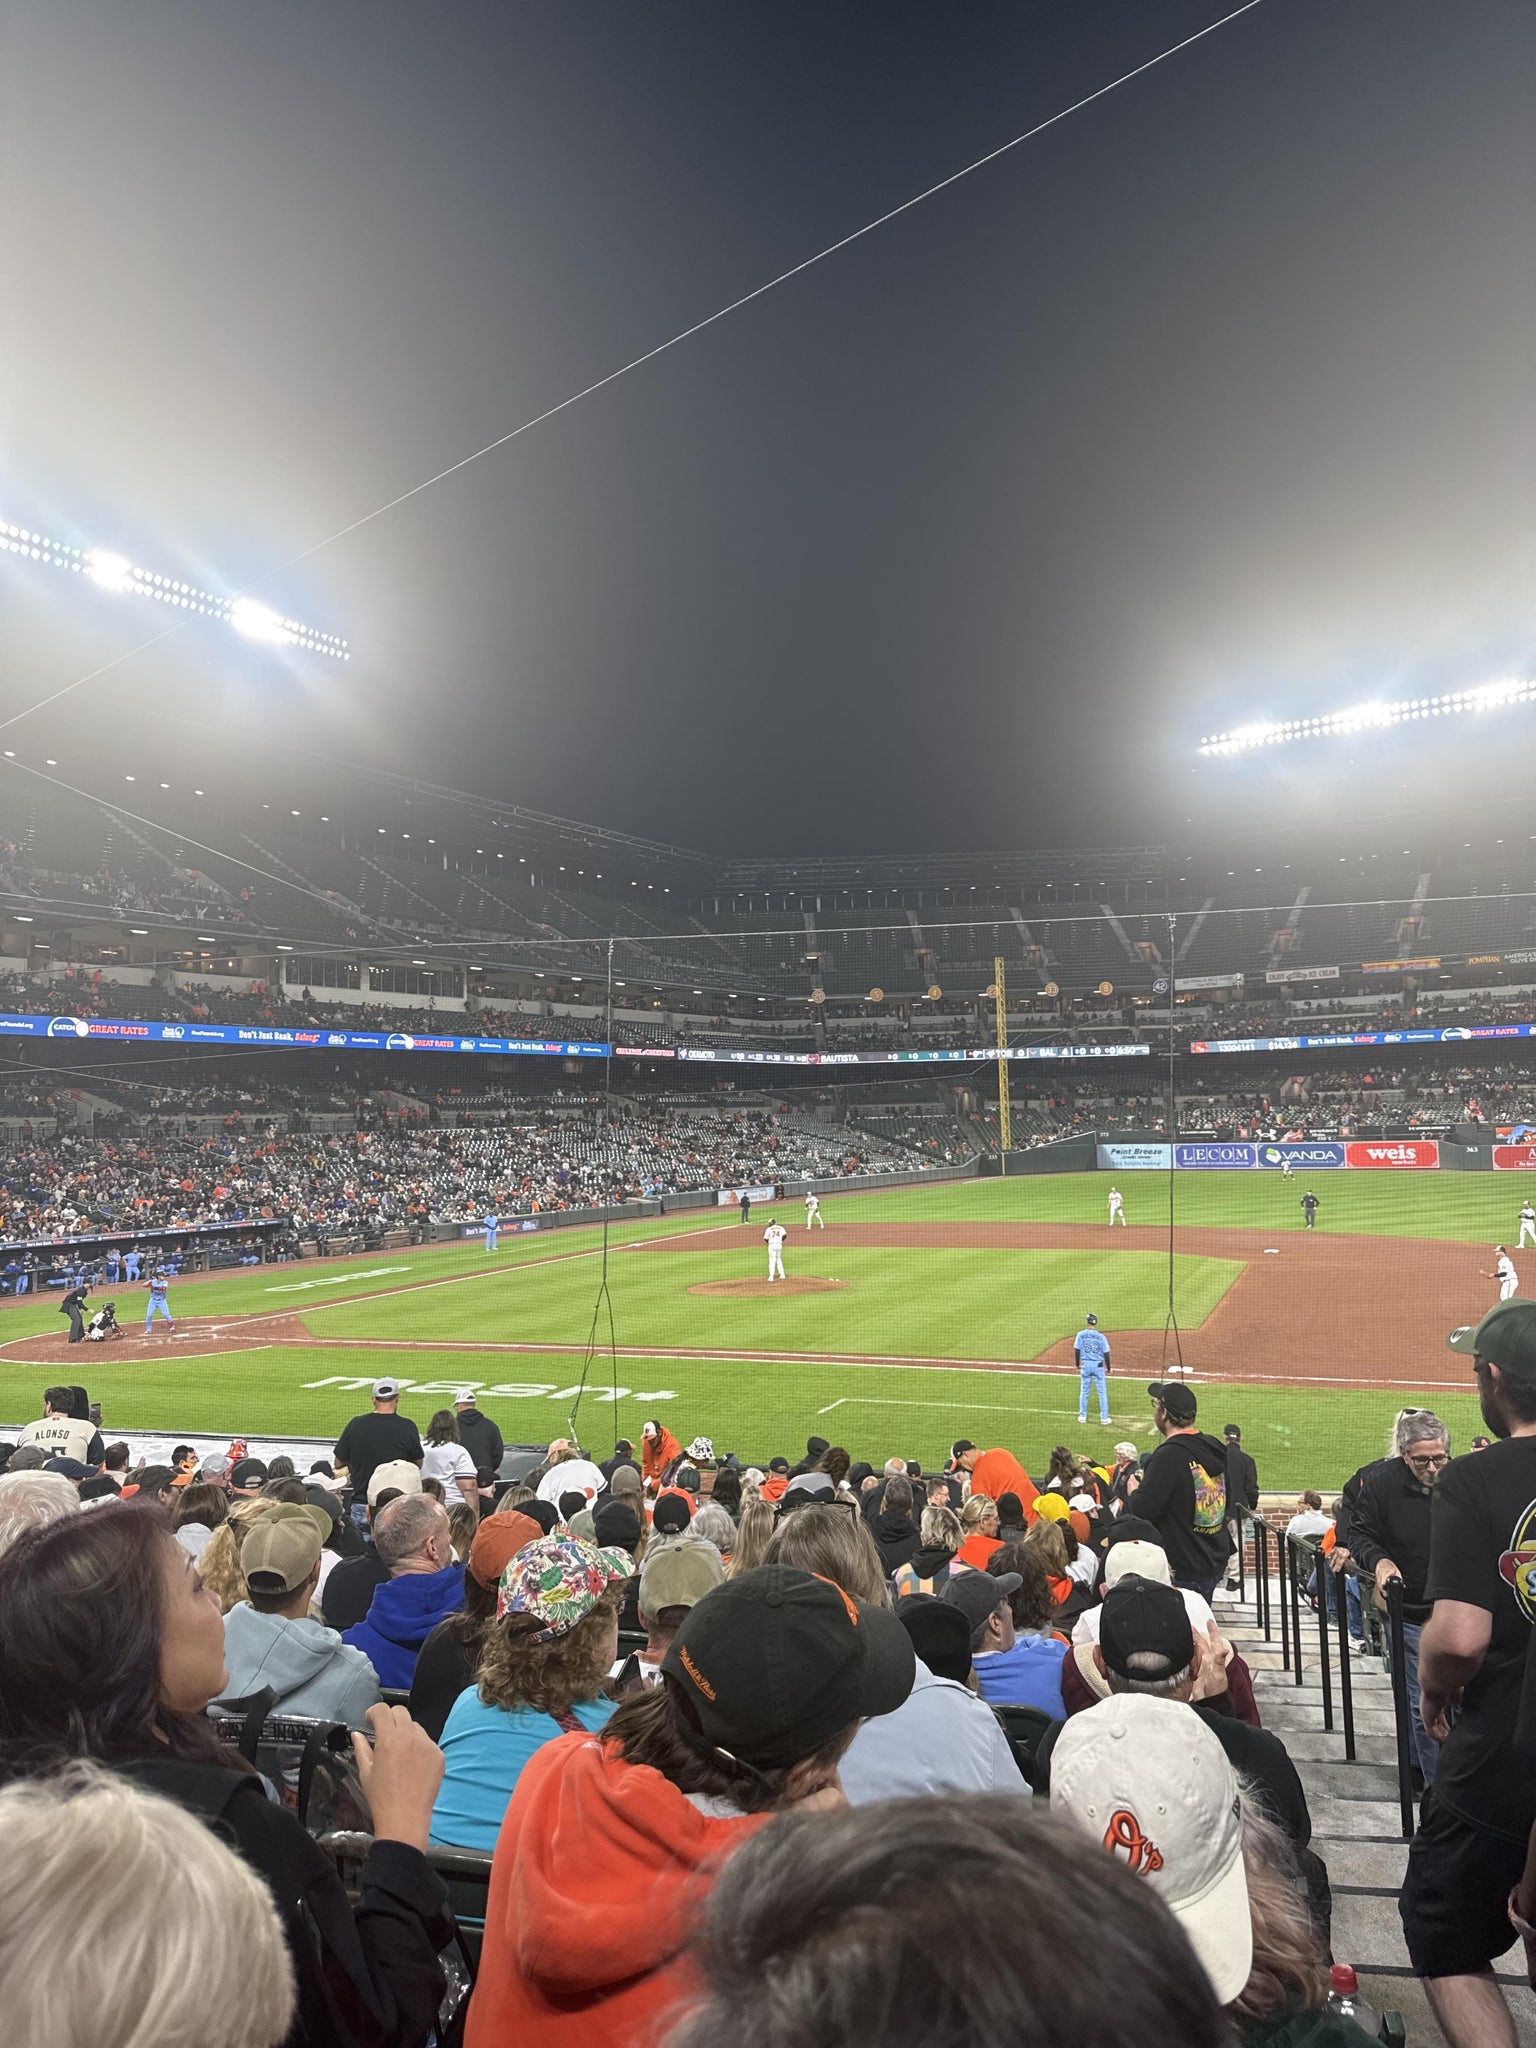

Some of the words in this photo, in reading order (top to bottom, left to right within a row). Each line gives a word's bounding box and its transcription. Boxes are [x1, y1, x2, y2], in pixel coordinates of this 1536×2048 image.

[1319, 969, 1336, 977] CREAM
[1047, 986, 1057, 995] 33
[1154, 982, 1165, 991] 42
[813, 991, 824, 1000] 20
[874, 990, 880, 999] 5
[932, 989, 938, 998] 4
[53, 1023, 76, 1031] CATCH
[89, 1024, 119, 1034] GREAT
[120, 1026, 149, 1035] RATES
[238, 1030, 257, 1039] Don't
[258, 1031, 273, 1040] Just
[996, 1049, 1013, 1058] TOR
[1040, 1048, 1056, 1057] BAL
[820, 1054, 859, 1063] BAUTISTA
[1183, 1148, 1249, 1161] LECOM
[1282, 1151, 1338, 1160] VANDA
[1366, 1144, 1417, 1160] weis
[771, 1230, 780, 1238] 74
[1082, 1340, 1100, 1354] 53
[35, 1429, 70, 1441] ALONSO
